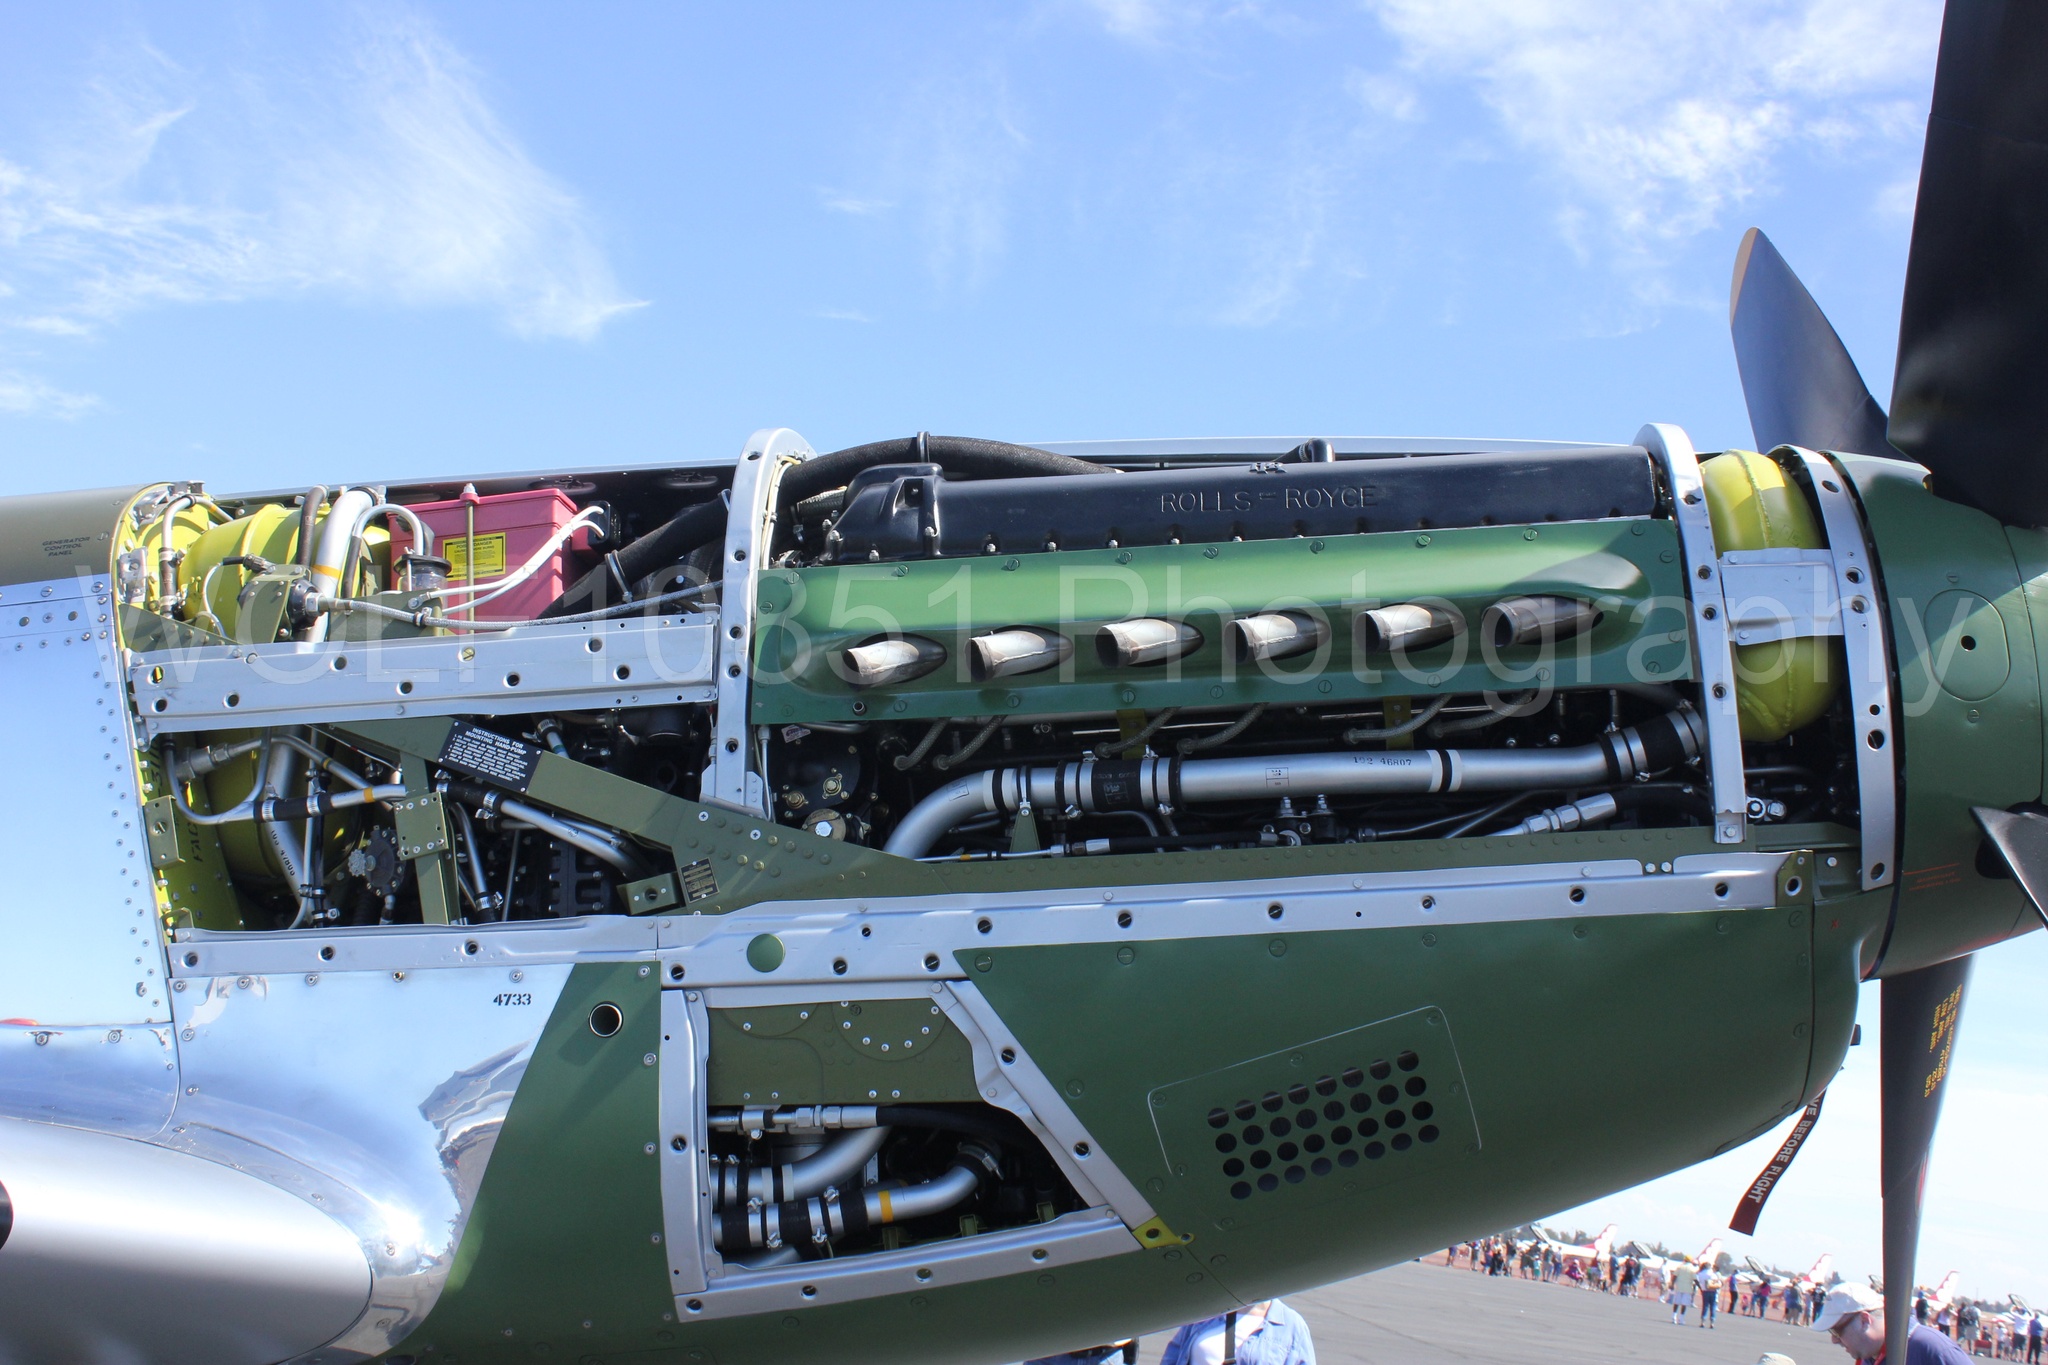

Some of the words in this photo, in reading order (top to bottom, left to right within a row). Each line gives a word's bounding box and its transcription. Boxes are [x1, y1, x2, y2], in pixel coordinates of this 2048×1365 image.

[1160, 490, 1252, 513] ROLLS
[1284, 485, 1379, 509] ROYCE
[42, 536, 90, 546] GENERATOR
[44, 543, 82, 551] CONTROL
[464, 730, 494, 744] MOUNTING
[494, 741, 527, 756] HAND-PUMP
[472, 727, 511, 745] INSTRUCTIONS
[511, 741, 525, 749] FOR
[492, 993, 532, 1006] 4733
[1776, 1119, 1813, 1163] BEFORE
[1747, 1164, 1784, 1203] FLIGHT
